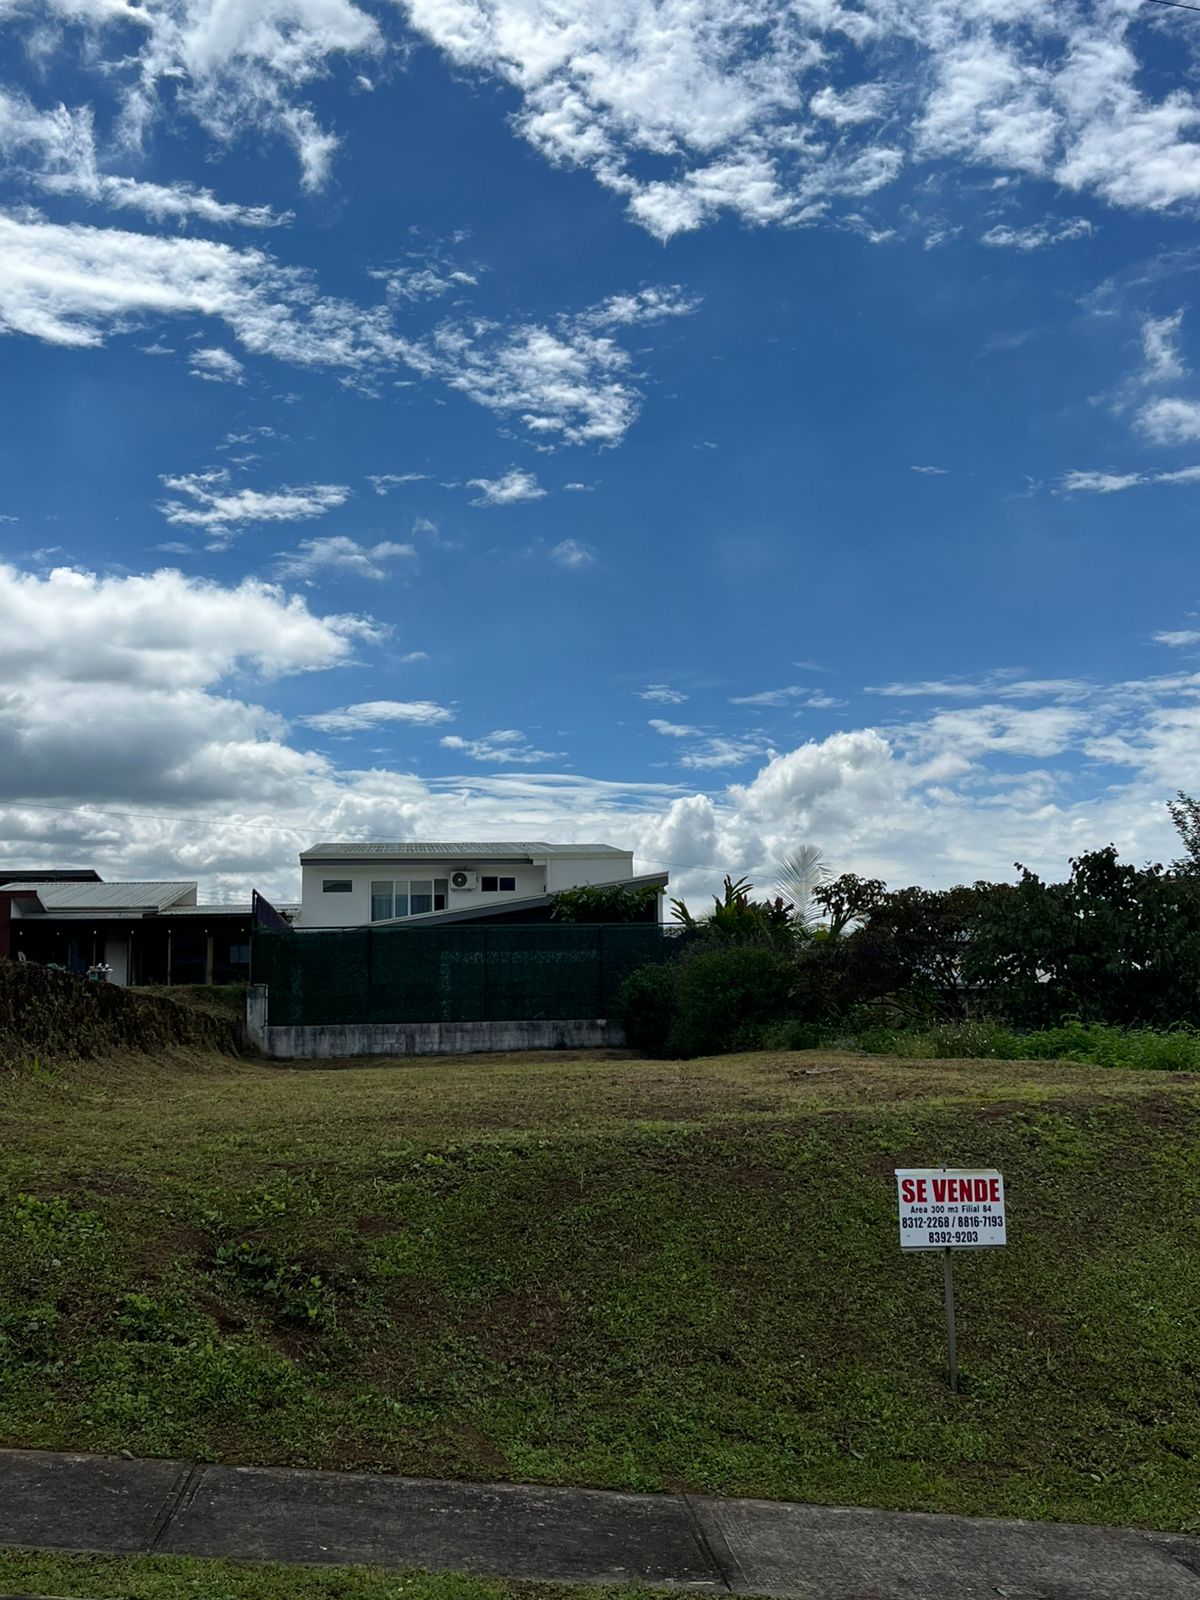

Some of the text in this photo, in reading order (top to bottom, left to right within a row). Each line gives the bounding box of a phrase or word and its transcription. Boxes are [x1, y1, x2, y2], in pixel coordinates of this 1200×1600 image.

[901, 1178, 1000, 1203] SE VENDE
[910, 1205, 928, 1214] Area
[931, 1205, 944, 1213] 300
[961, 1205, 979, 1213] Filial
[902, 1216, 949, 1228] 8312-2268
[957, 1215, 1003, 1228] 8816-7193
[928, 1231, 978, 1243] 8392-9203
